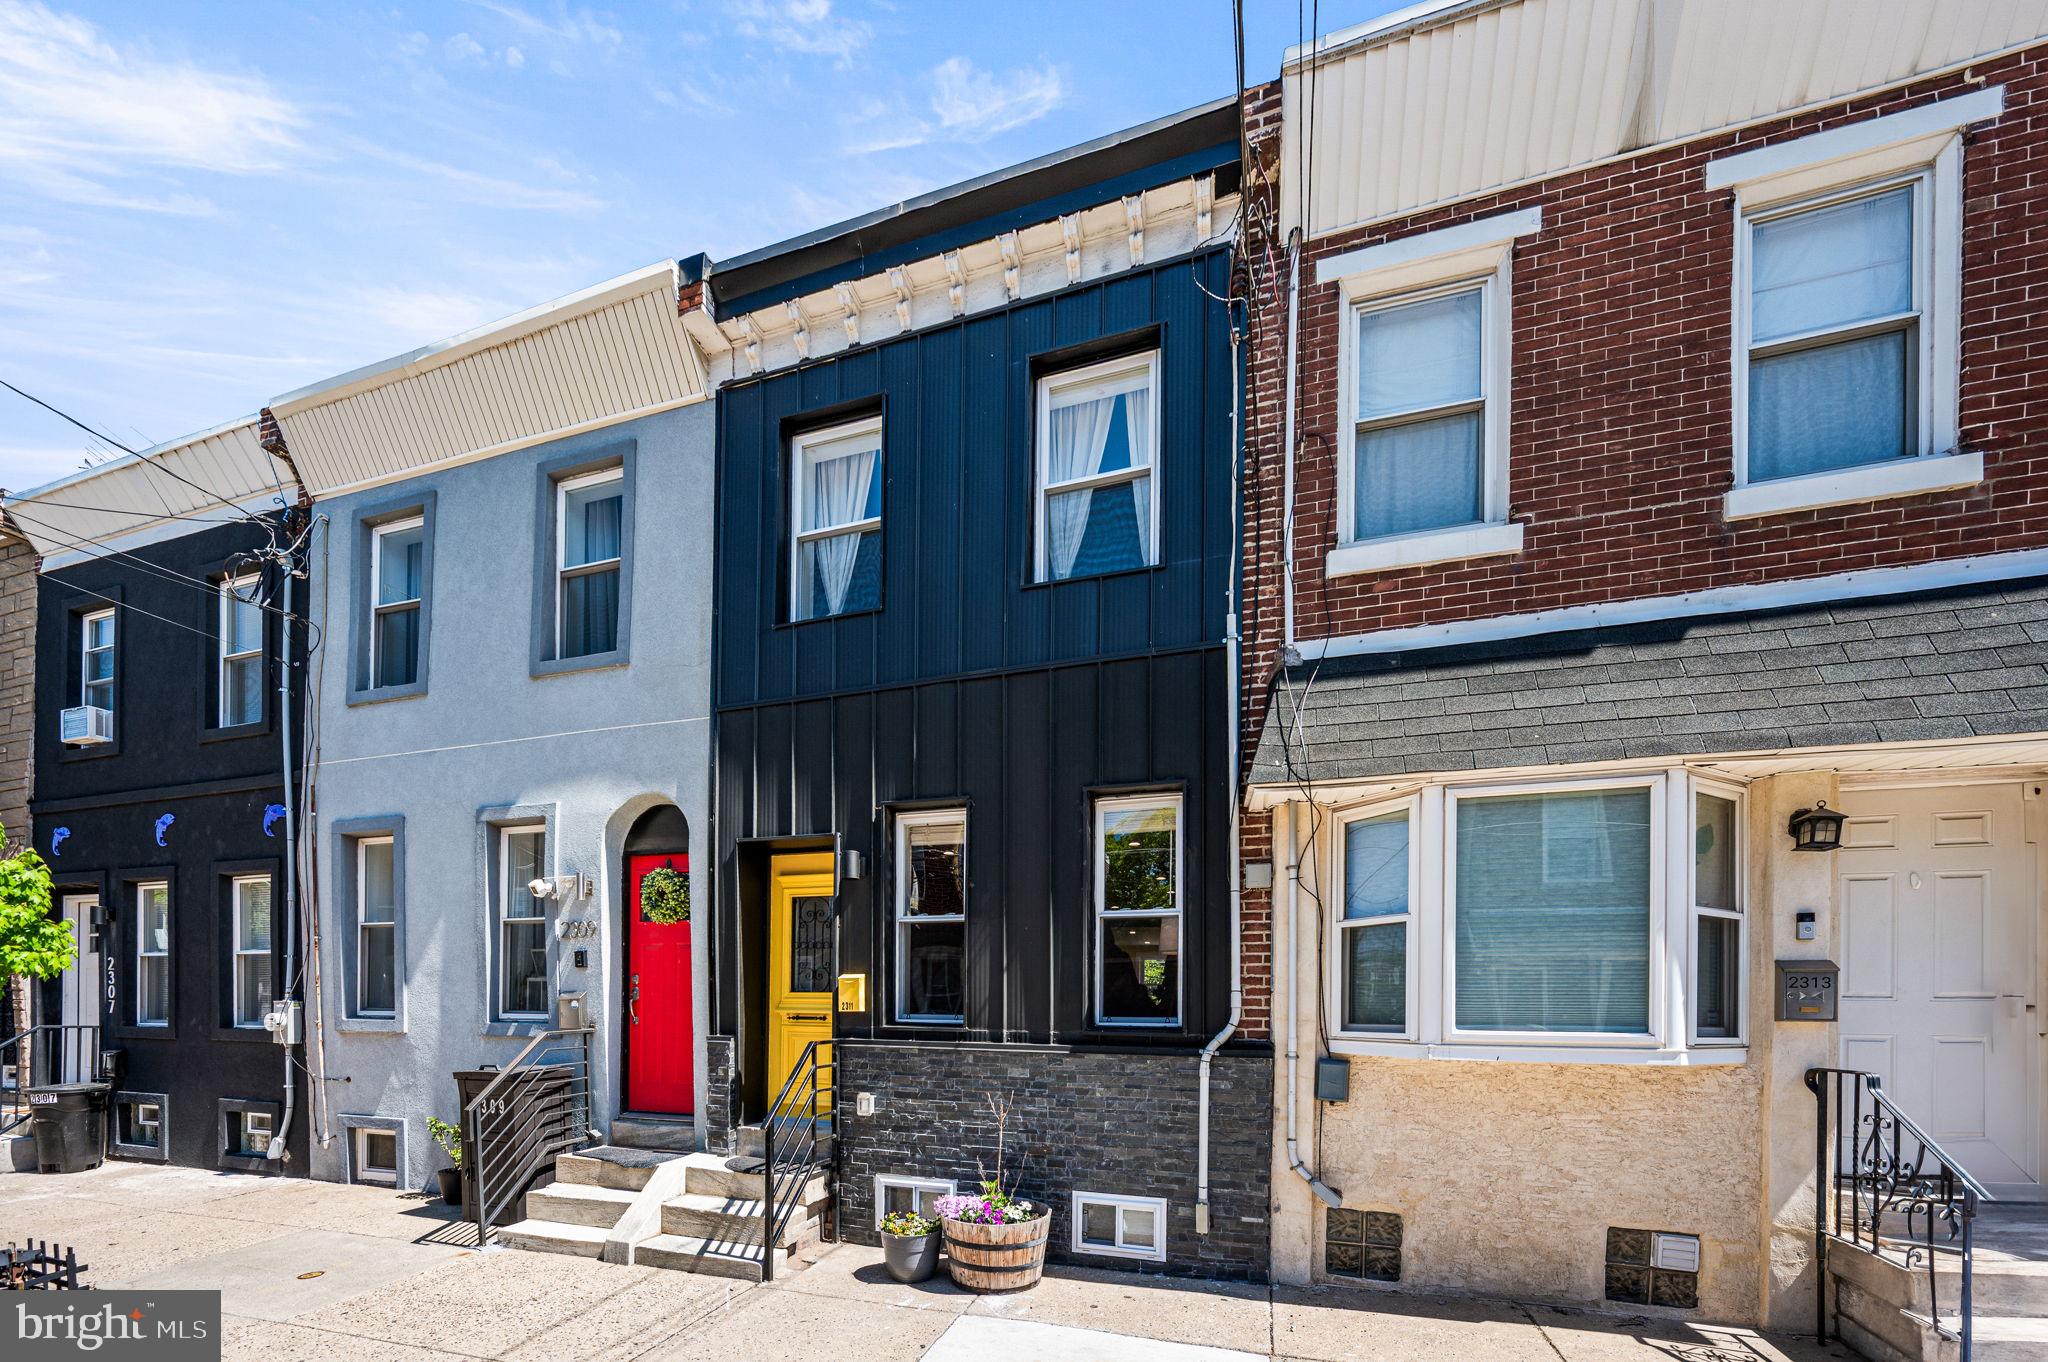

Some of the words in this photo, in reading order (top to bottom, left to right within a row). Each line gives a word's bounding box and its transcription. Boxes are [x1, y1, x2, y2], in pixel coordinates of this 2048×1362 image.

[560, 920, 598, 939] 2309
[107, 956, 116, 1014] 2307
[1788, 976, 1831, 989] 2313
[841, 1001, 854, 1011] 2311
[30, 1094, 56, 1104] 2307
